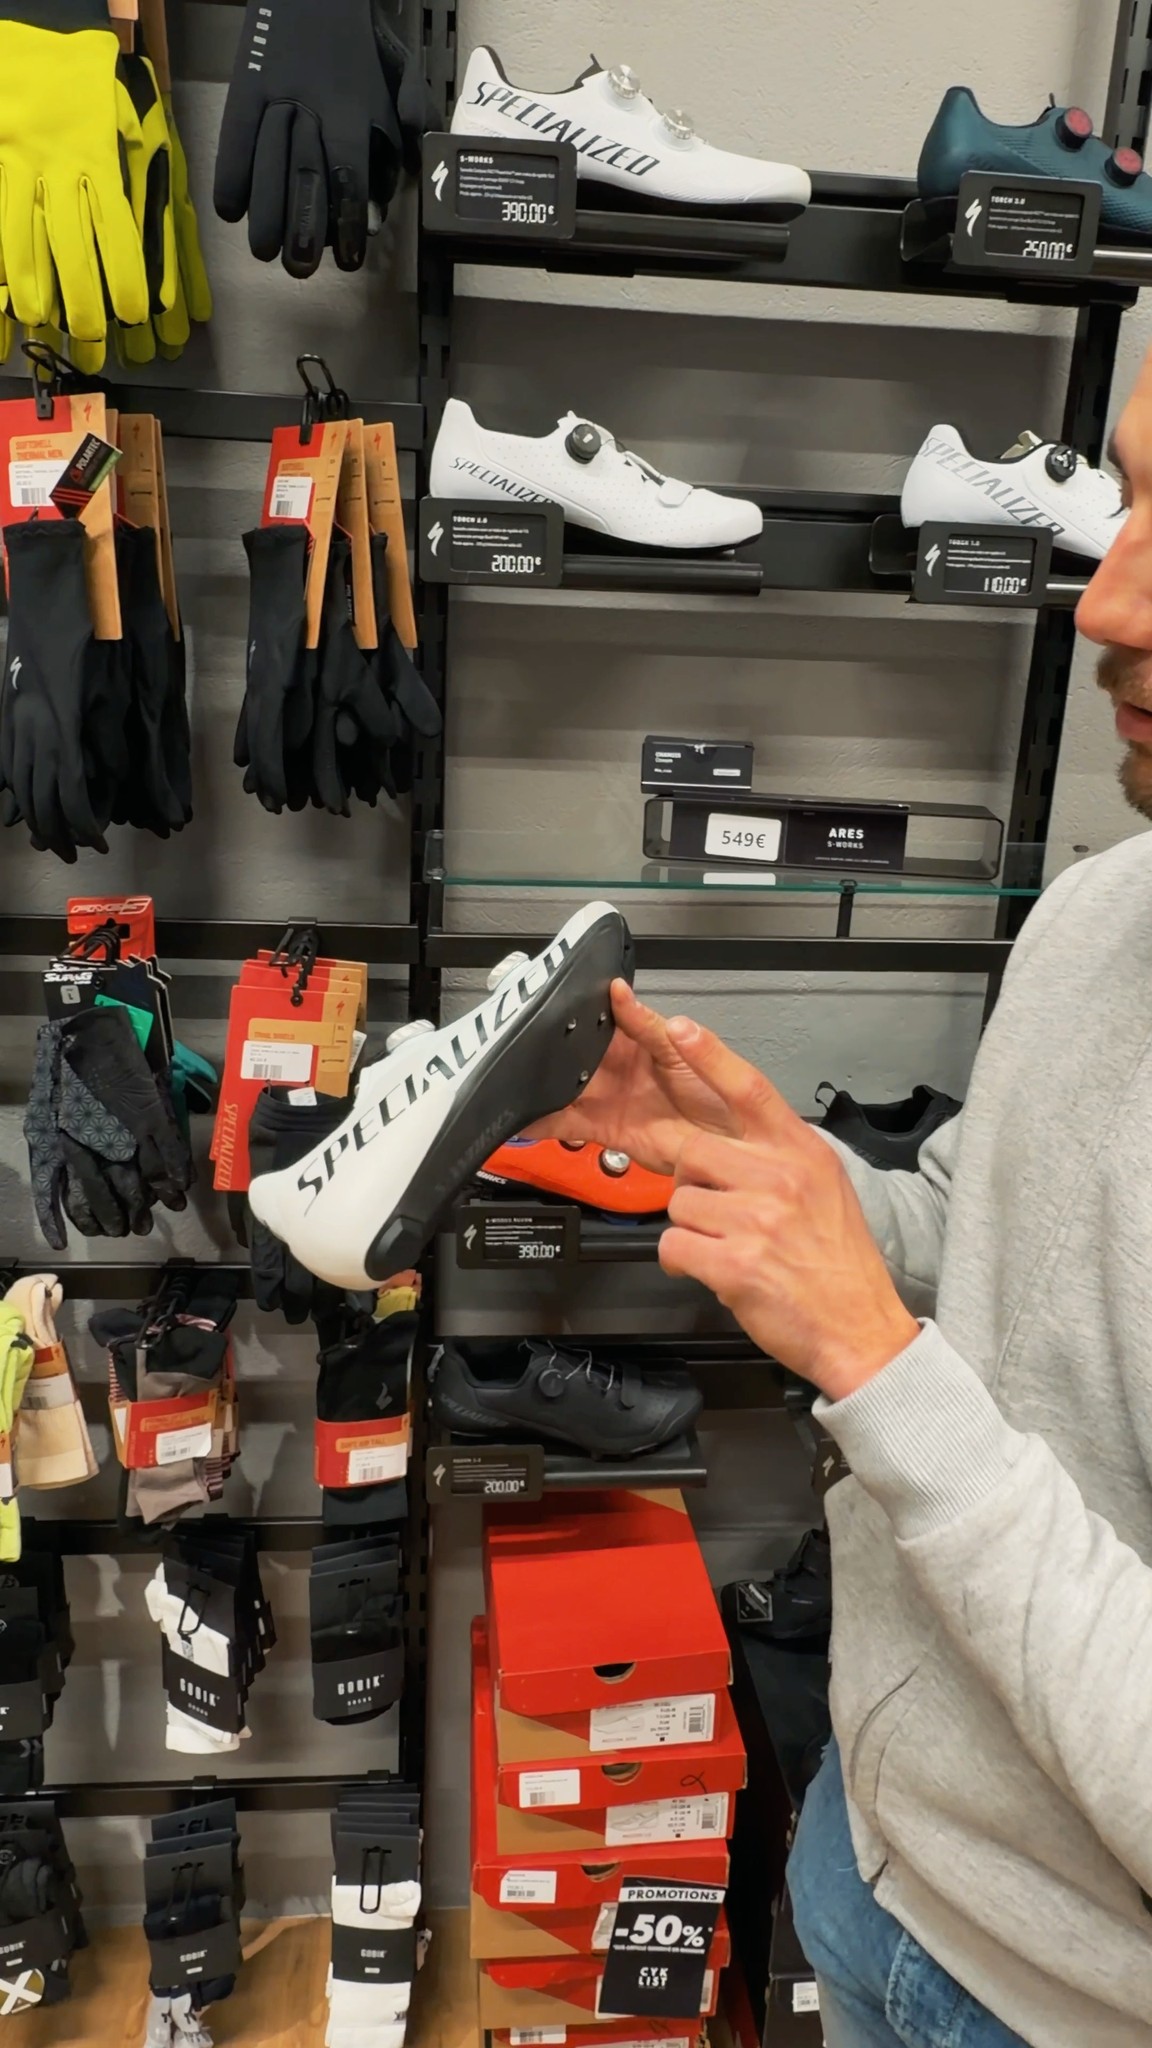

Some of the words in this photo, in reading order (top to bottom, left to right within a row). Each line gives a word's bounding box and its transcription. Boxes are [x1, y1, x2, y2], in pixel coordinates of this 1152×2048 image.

[466, 81, 660, 176] SPECIALIZED
[460, 155, 494, 164] S-WORKS
[828, 827, 864, 839] ARES
[721, 830, 766, 849] 549€
[827, 840, 864, 849] S-WORKS
[297, 937, 572, 1216] SPECIALIZED
[627, 1889, 718, 1900] PROMOTIONS
[640, 1966, 668, 1977] CYK
[638, 1976, 668, 1987] LIST
